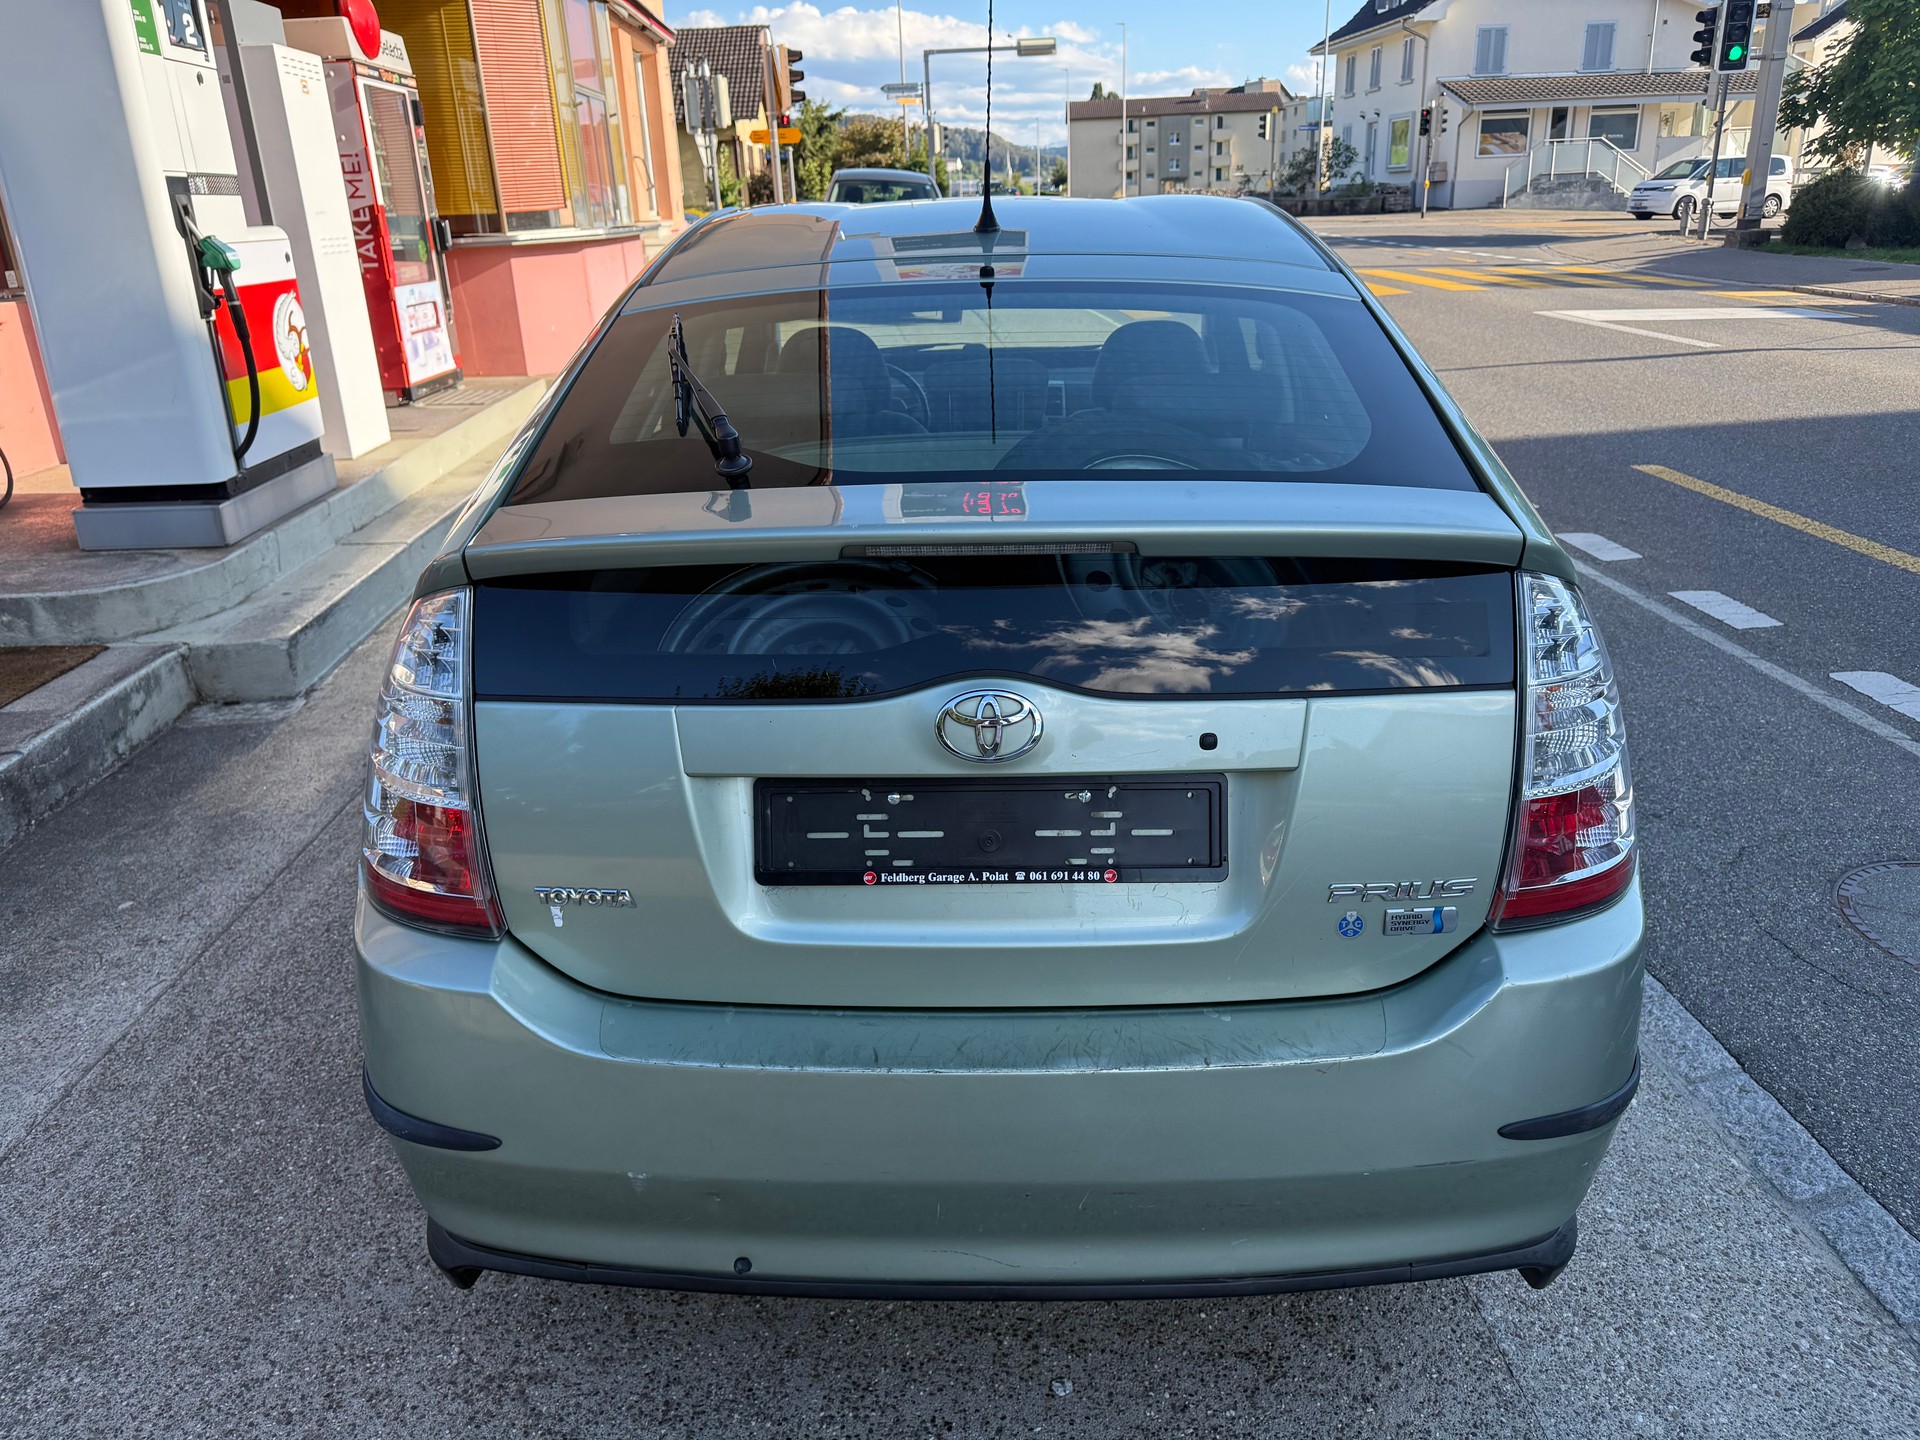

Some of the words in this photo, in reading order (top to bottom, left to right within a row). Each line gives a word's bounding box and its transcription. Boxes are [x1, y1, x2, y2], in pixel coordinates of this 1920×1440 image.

[182, 12, 198, 46] 2
[340, 152, 366, 199] ME!
[352, 206, 379, 273] TAKE
[880, 872, 926, 884] Feldberg
[928, 871, 965, 883] Garage
[967, 871, 979, 882] A.
[982, 871, 1009, 881] Polat
[1029, 870, 1048, 881] 061
[1050, 870, 1069, 881] 691
[1071, 870, 1085, 881] 44
[1087, 870, 1100, 881] 80
[1328, 877, 1478, 903] PRIUS
[534, 887, 637, 908] TOYOTA
[1391, 913, 1423, 921] HYBRID
